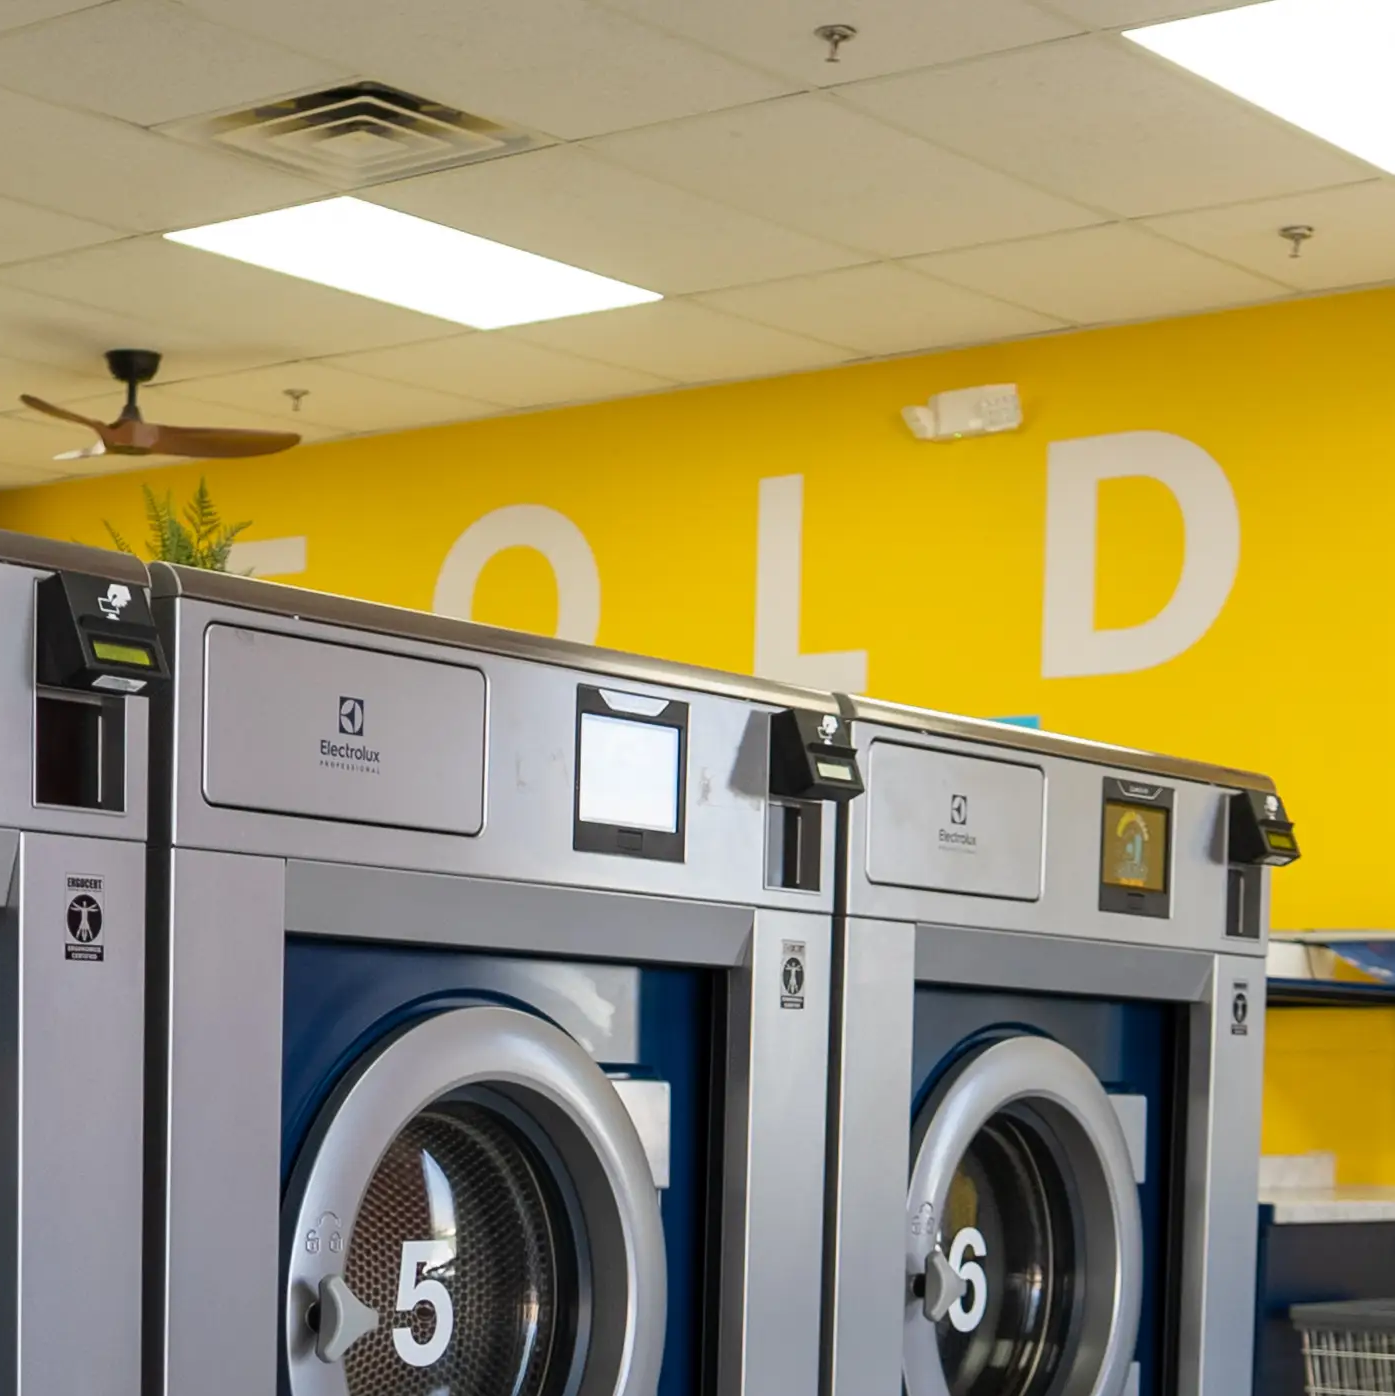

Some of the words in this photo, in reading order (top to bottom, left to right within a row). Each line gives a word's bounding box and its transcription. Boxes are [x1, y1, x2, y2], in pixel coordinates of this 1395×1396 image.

[227, 430, 1241, 694] OLD
[320, 739, 380, 763] Electrolux
[392, 1239, 456, 1367] 5
[948, 1226, 987, 1333] 6
